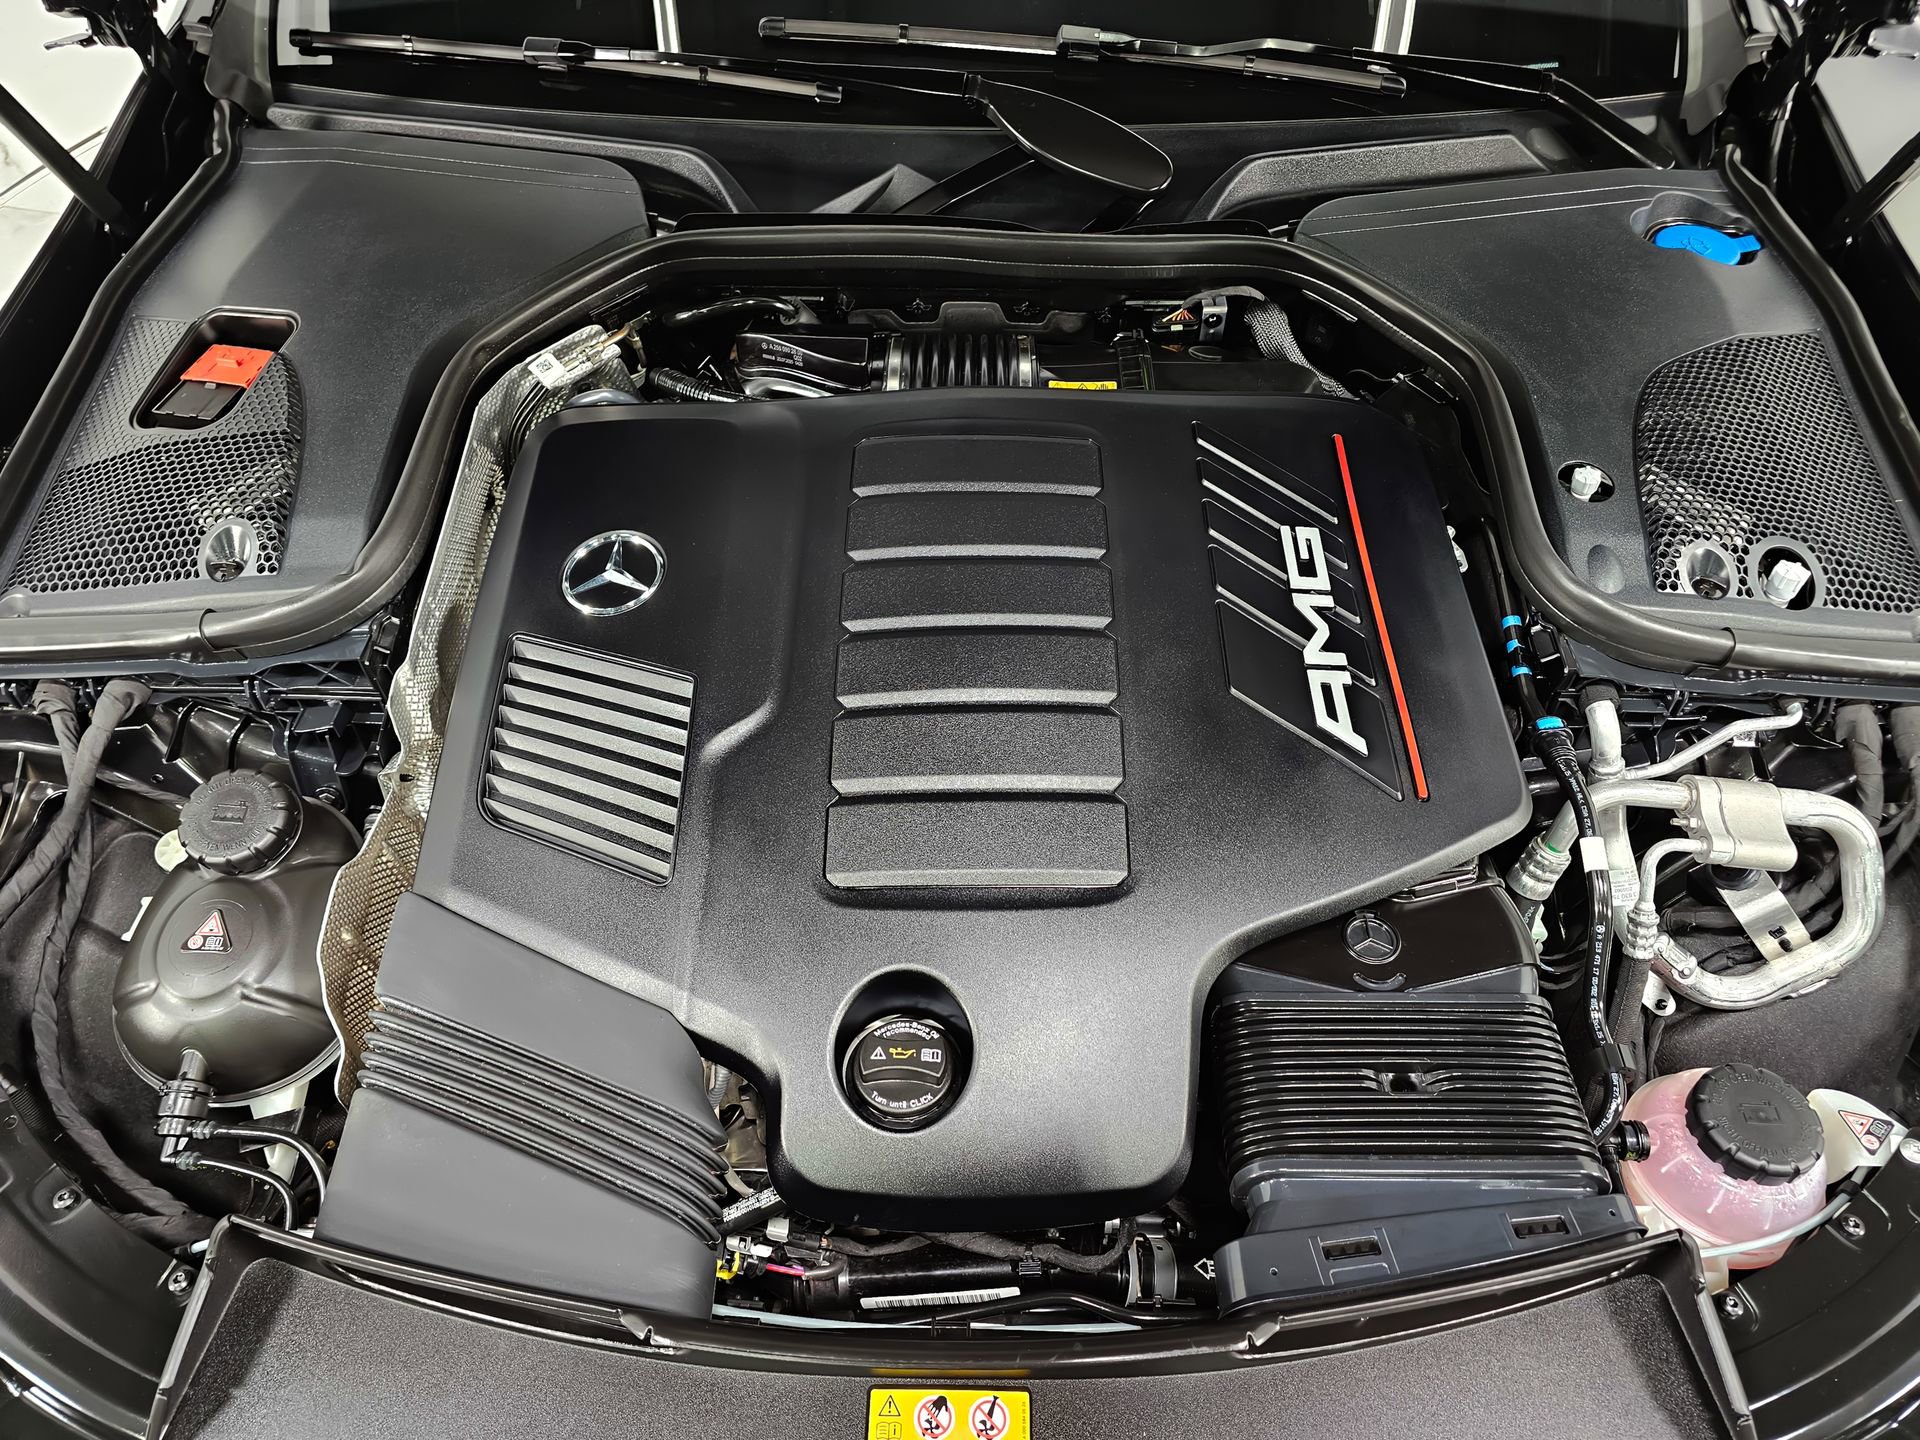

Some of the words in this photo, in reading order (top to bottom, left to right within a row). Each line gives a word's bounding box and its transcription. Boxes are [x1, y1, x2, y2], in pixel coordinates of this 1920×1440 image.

[1279, 525, 1369, 758] AMG
[1593, 955, 1601, 966] 471
[1593, 967, 1599, 976] 17
[873, 1021, 931, 1037] Mercedes-Benz
[882, 1027, 931, 1041] recommended
[871, 1090, 888, 1105] Turn
[889, 1100, 907, 1109] until
[909, 1092, 934, 1108] CLICK
